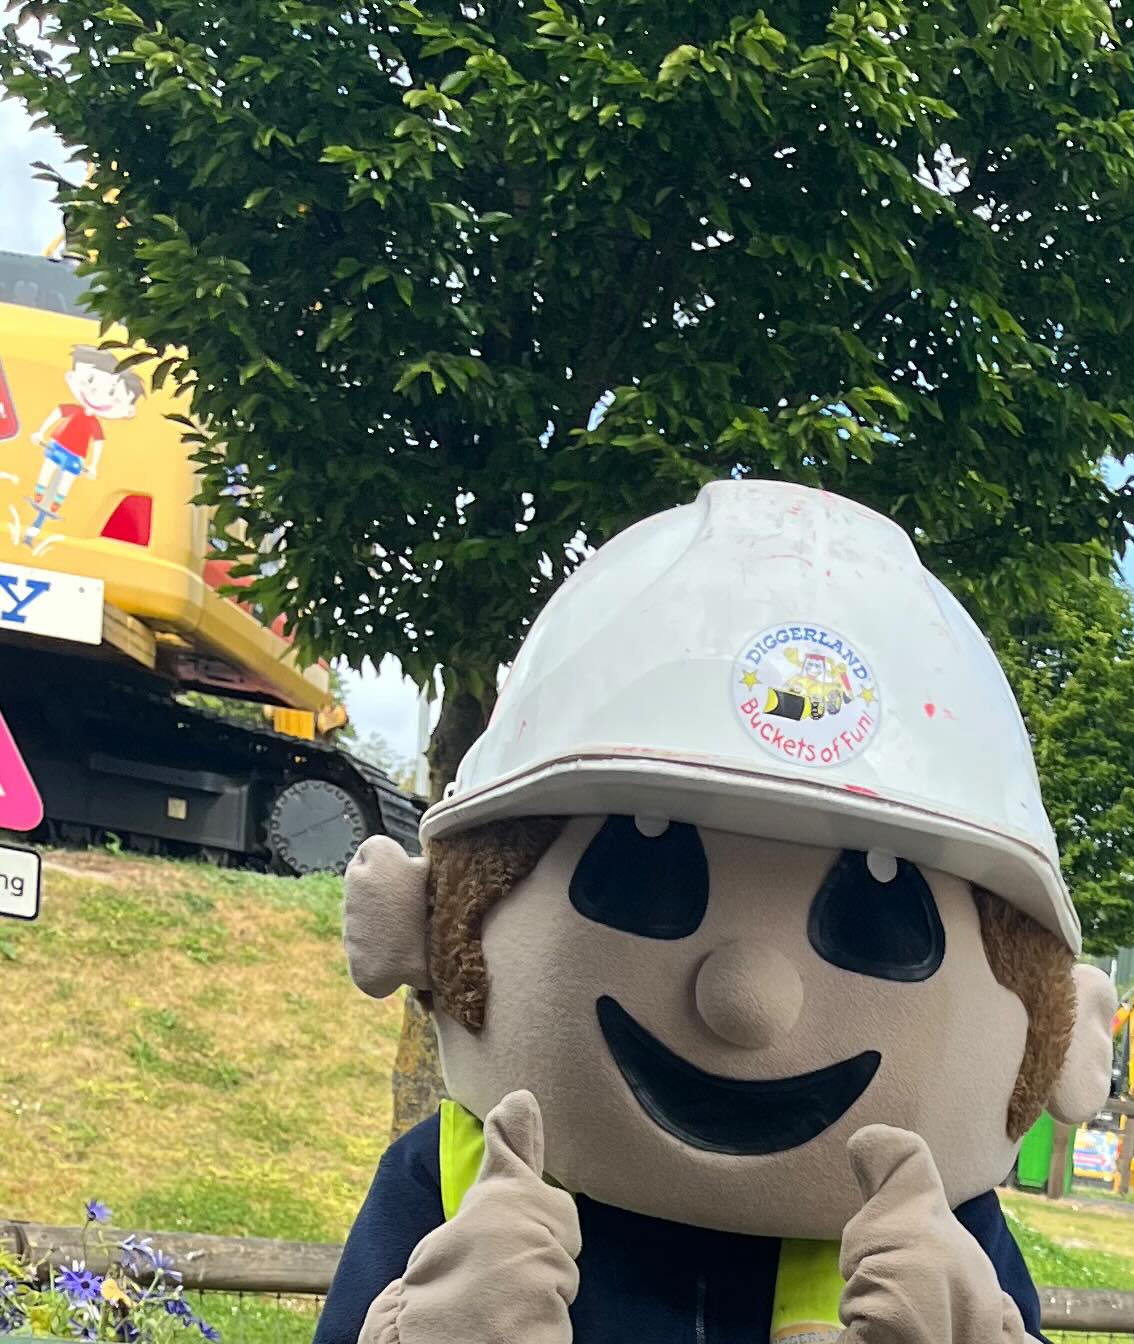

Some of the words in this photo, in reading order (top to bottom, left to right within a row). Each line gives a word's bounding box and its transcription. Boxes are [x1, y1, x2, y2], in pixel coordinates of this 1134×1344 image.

[0, 574, 50, 623] Y
[746, 627, 868, 680] DIGGERLAND
[740, 697, 816, 762] Buckets
[820, 737, 842, 763] of
